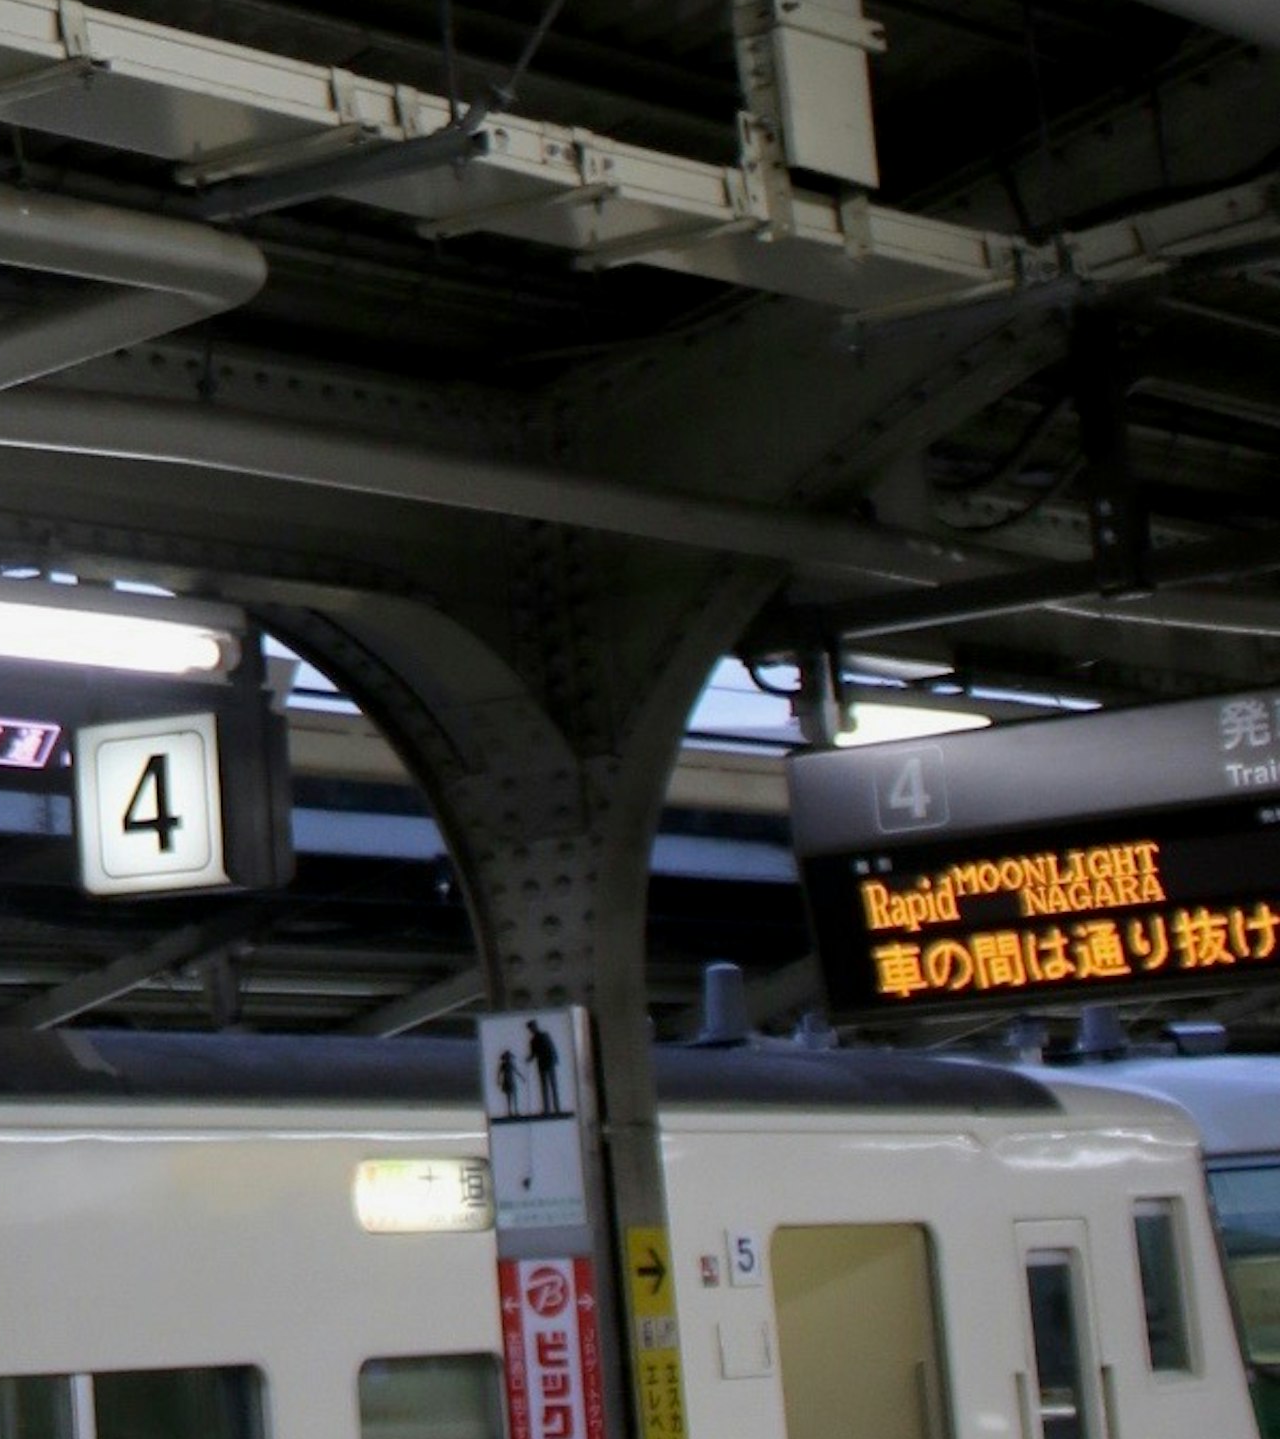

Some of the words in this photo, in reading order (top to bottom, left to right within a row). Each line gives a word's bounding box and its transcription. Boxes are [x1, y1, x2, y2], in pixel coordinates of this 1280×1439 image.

[1221, 696, 1280, 751] 発
[888, 757, 932, 819] 4
[1226, 759, 1280, 789] Trai
[122, 753, 186, 855] 4
[861, 873, 961, 933] Rapid
[953, 840, 1161, 898] MOONLIGHT
[1021, 872, 1166, 919] NAGARA
[872, 900, 1280, 999] 車の間は通り抜け
[737, 1235, 755, 1273] 5
